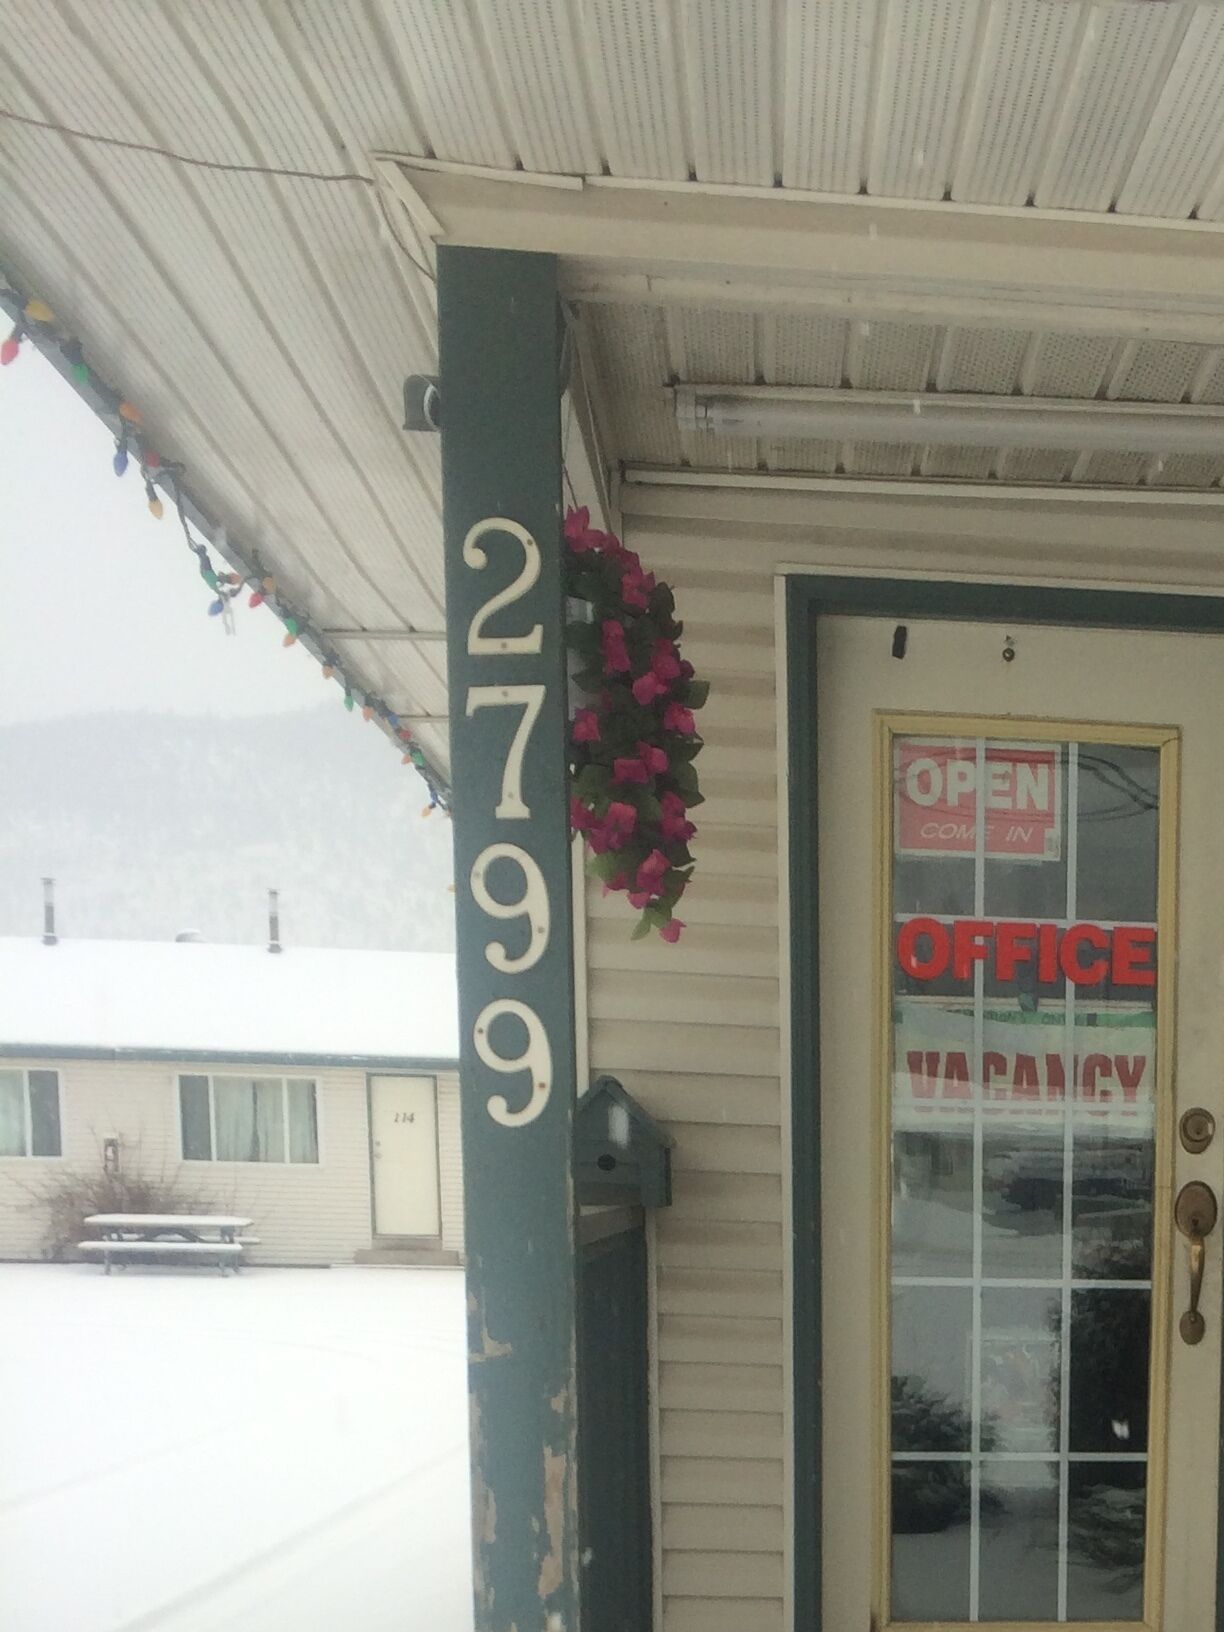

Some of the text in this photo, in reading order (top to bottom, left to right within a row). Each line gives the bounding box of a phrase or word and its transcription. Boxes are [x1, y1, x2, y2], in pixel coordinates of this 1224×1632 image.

[906, 757, 1049, 811] OPEN
[463, 516, 552, 1128] 2799
[1005, 825, 1034, 843] IN
[897, 917, 1157, 987] OFFICE
[906, 1050, 1147, 1117] VACANCY
[393, 1112, 415, 1124] 114
